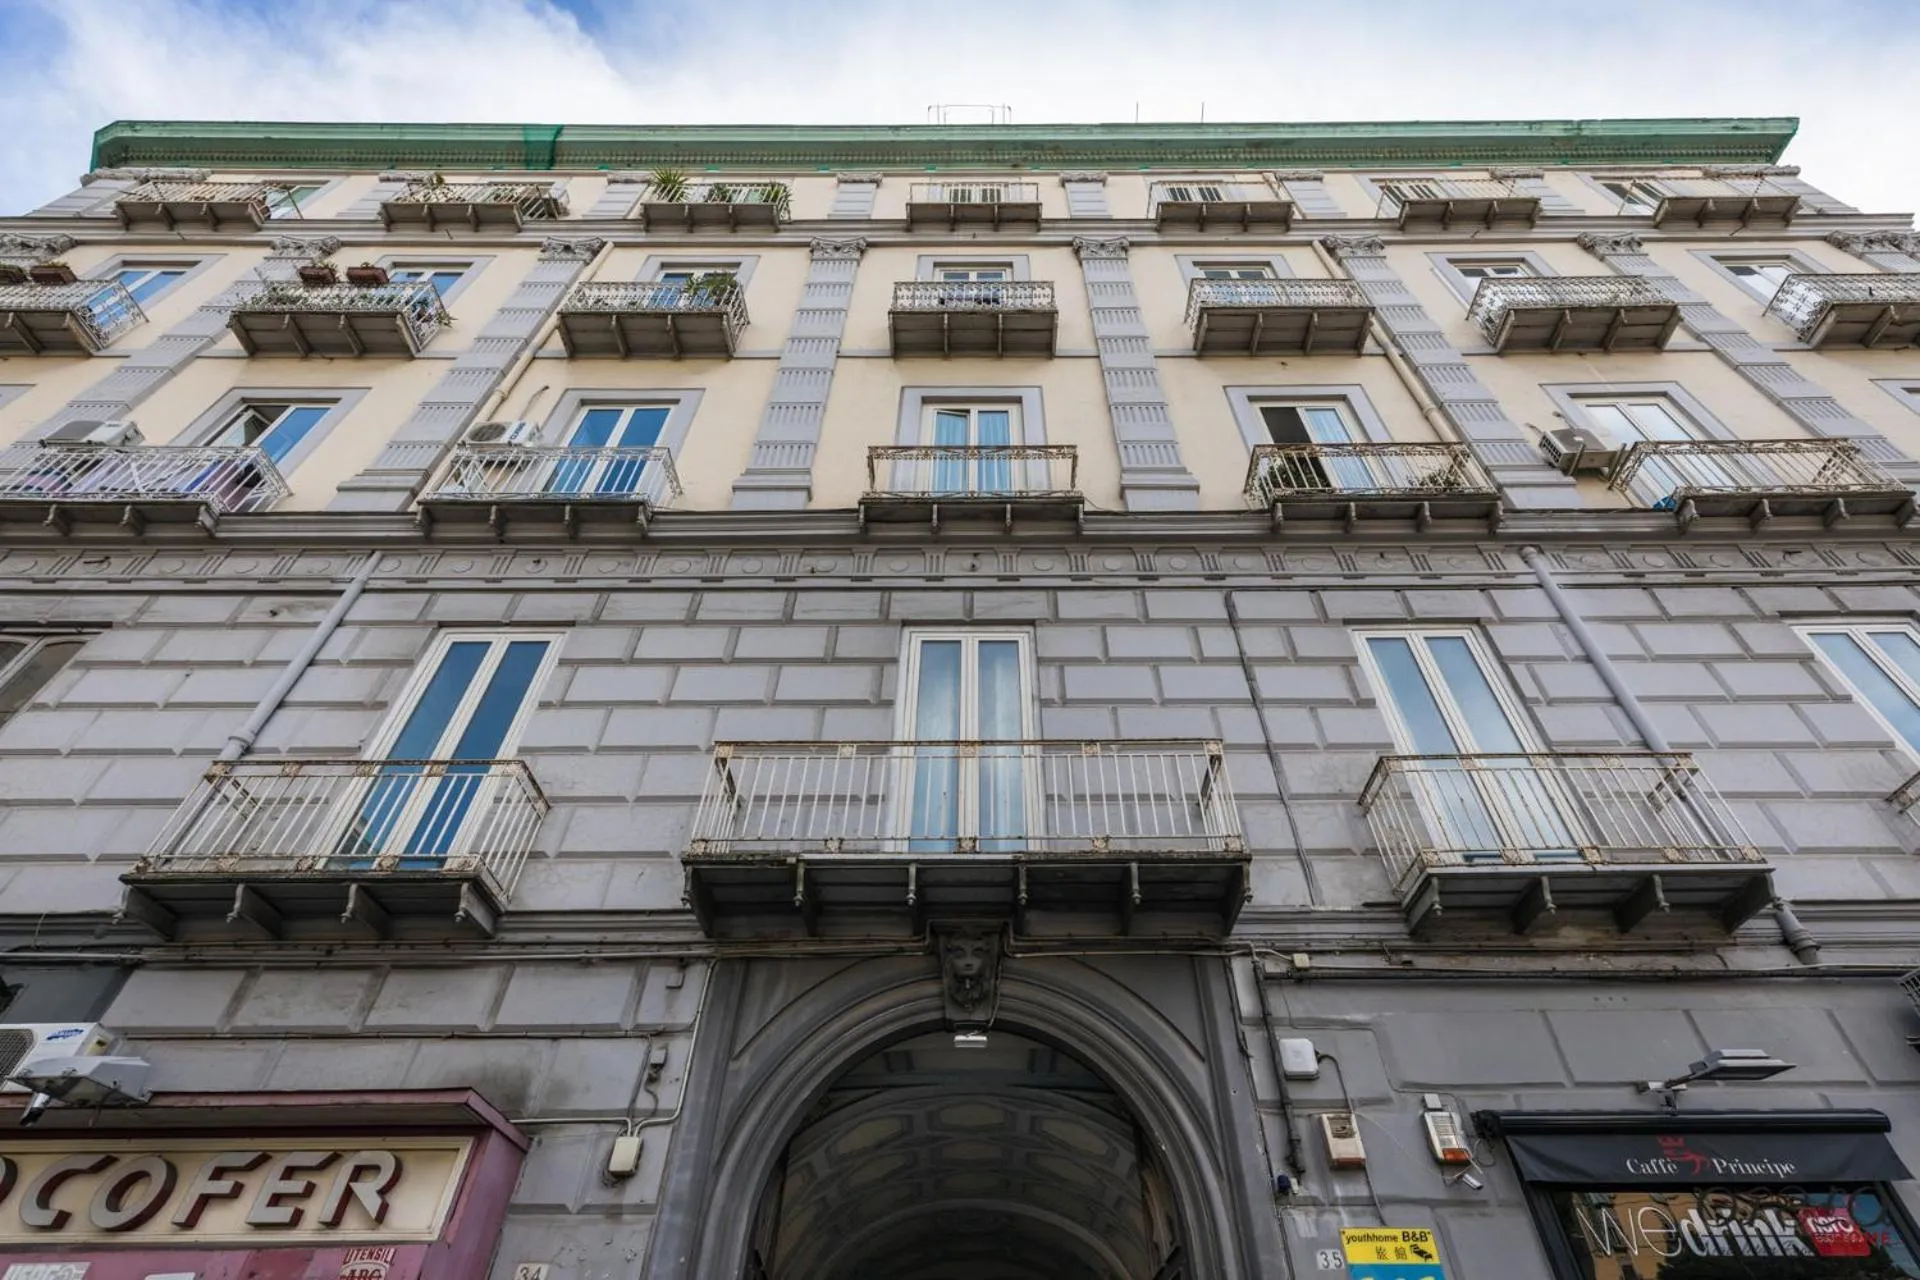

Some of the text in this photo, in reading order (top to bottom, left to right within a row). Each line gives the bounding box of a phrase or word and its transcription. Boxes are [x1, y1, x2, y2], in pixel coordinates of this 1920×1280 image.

[1711, 1157, 1797, 1179] Principe
[1346, 1230, 1428, 1245] youthhome B&B
[1320, 1251, 1342, 1269] 35
[520, 1265, 542, 1280] 34
